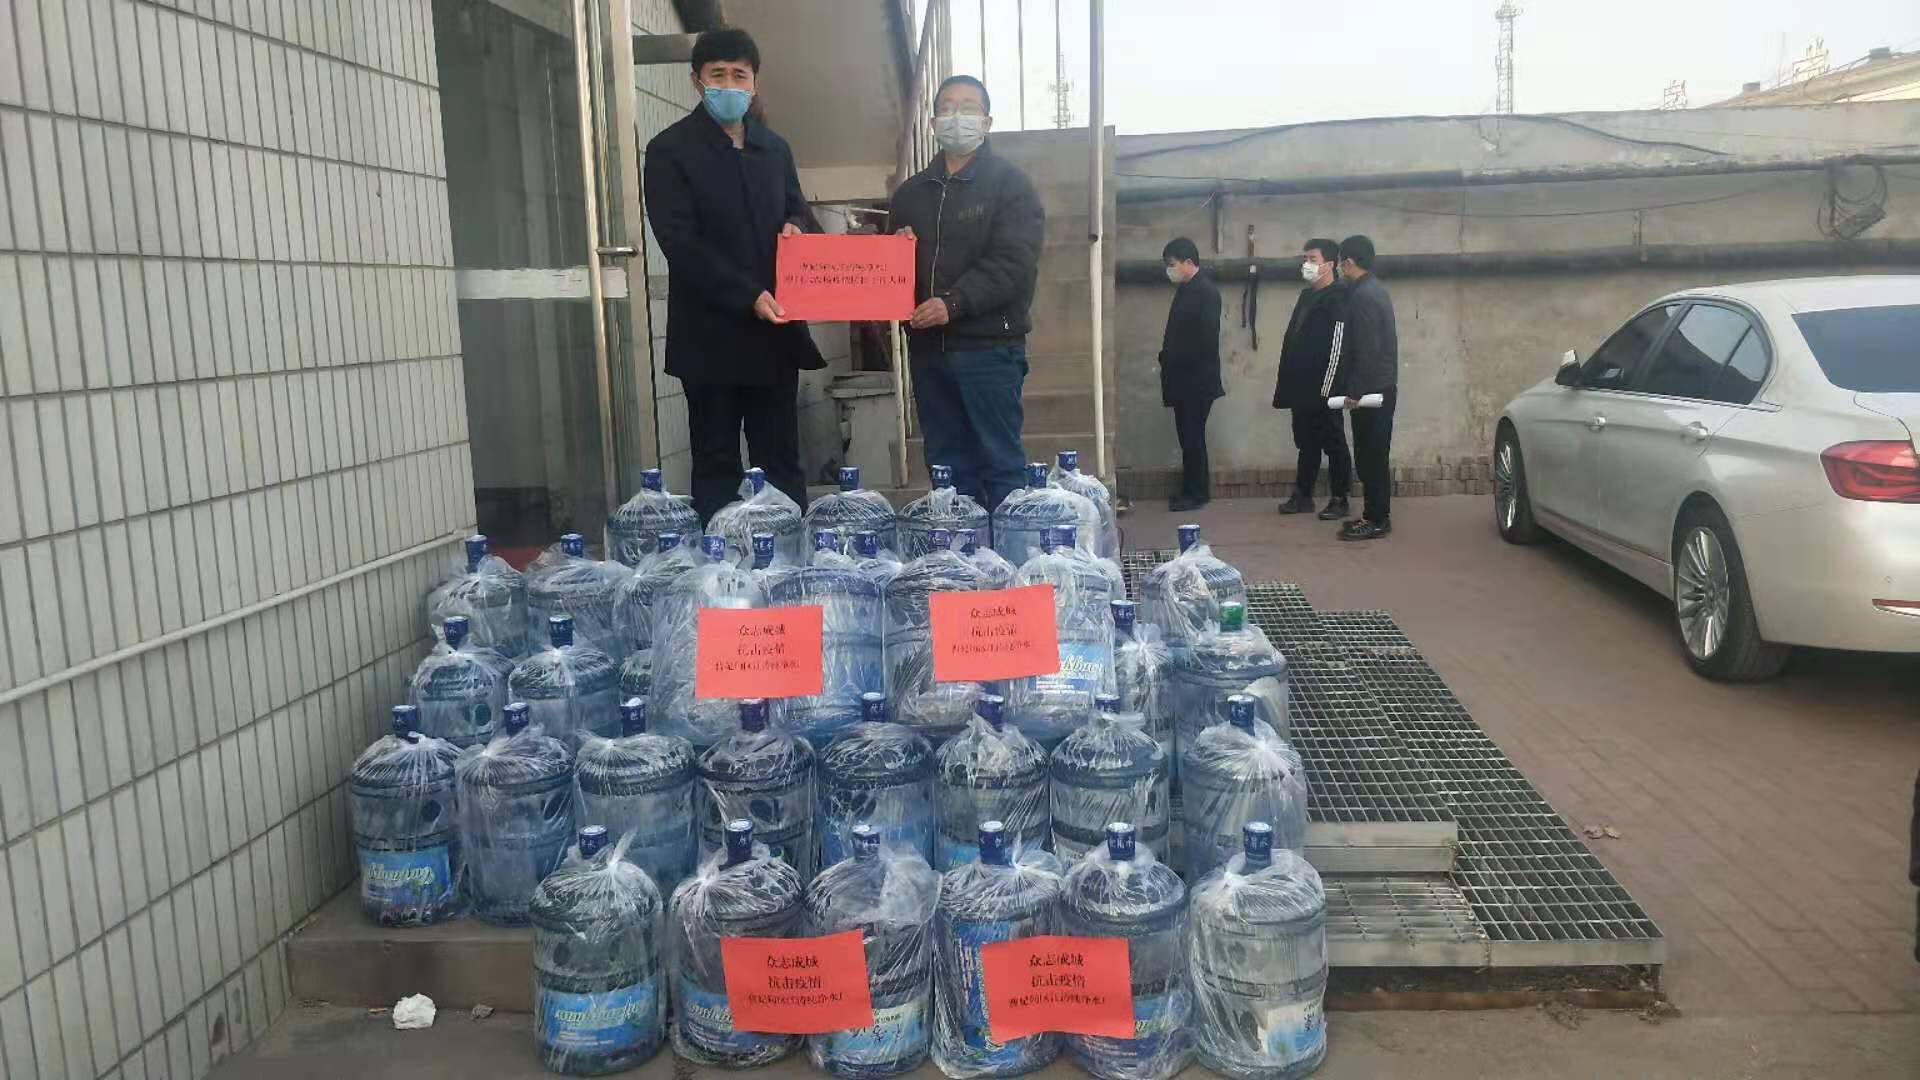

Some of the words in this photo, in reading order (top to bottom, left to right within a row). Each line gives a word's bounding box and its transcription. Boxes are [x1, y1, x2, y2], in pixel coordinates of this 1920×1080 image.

[767, 955, 820, 969] 众志成城
[1029, 953, 1085, 967] 众志成城
[767, 975, 822, 990] 抗击疫情
[1031, 973, 1086, 988] 抗击疫情
